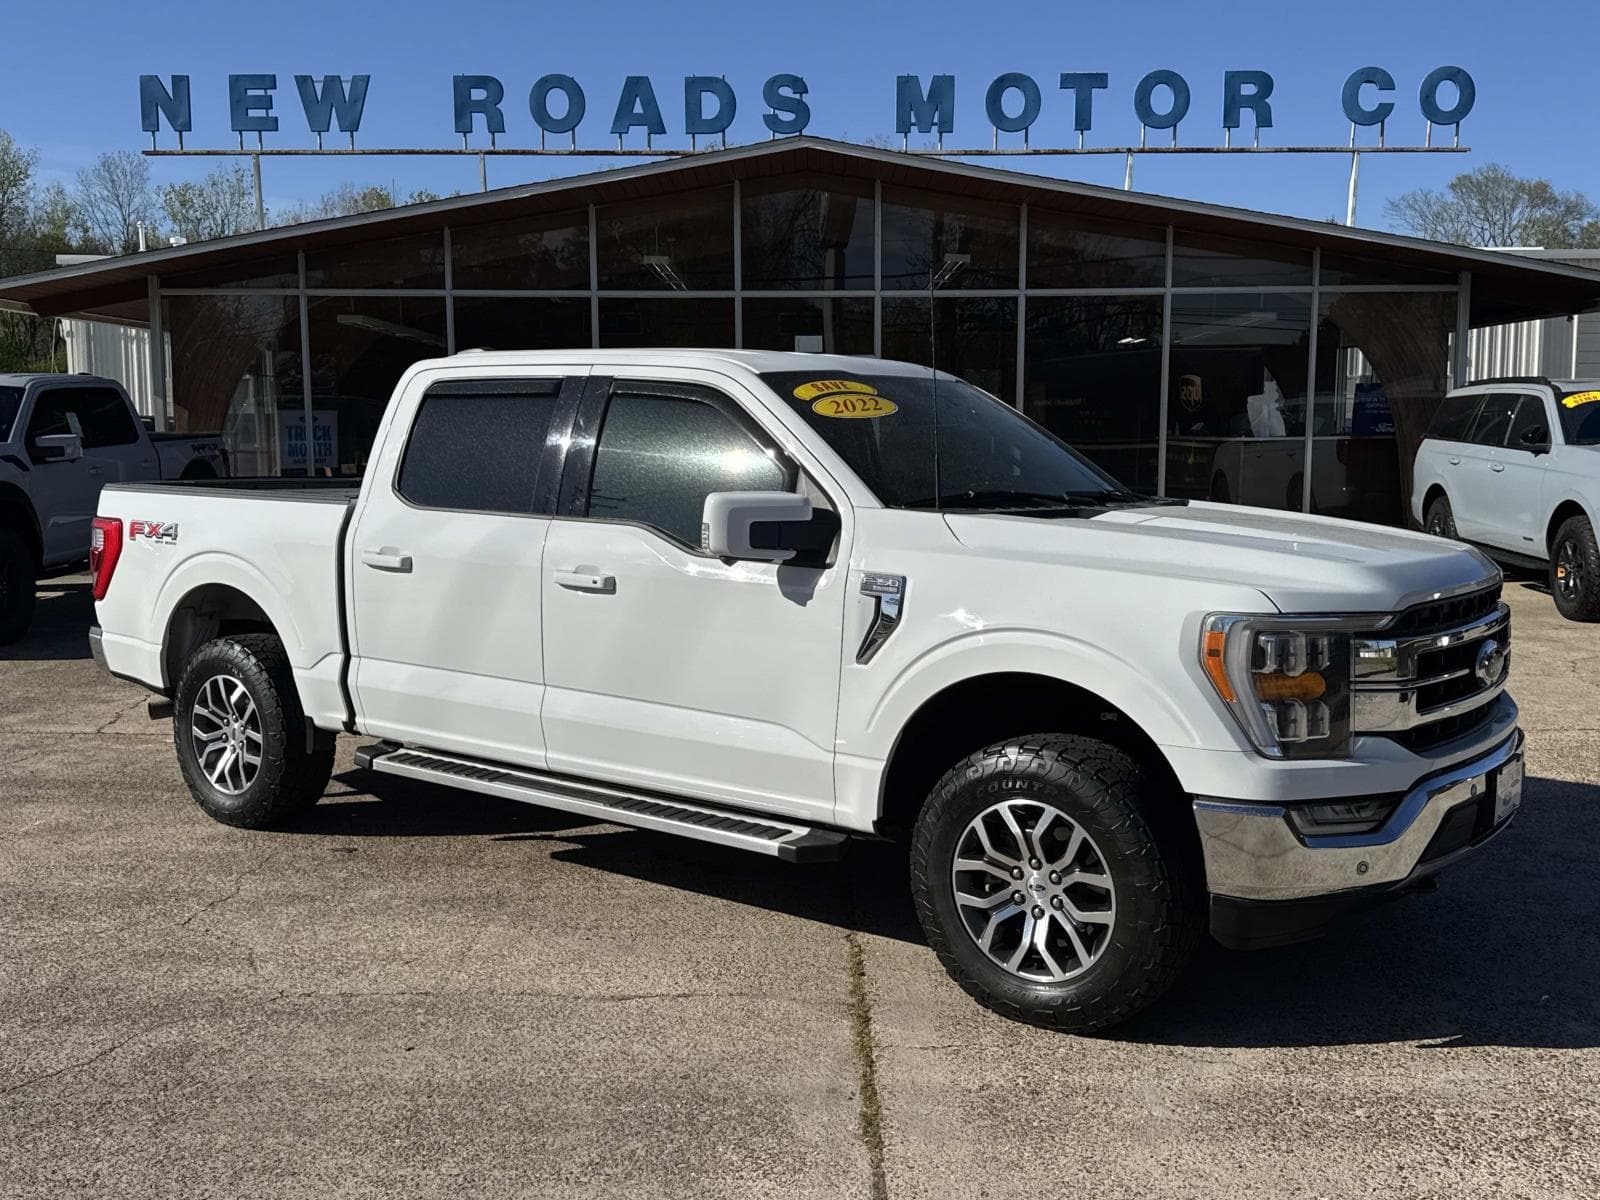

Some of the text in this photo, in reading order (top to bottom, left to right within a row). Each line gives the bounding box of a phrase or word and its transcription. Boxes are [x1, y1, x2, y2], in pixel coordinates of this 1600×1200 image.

[139, 66, 1476, 135] NEW ROADS MOTOR CO
[810, 381, 850, 392] SAVE
[829, 398, 883, 414] 2022
[286, 425, 332, 441] TRCK
[129, 520, 179, 541] FX4
